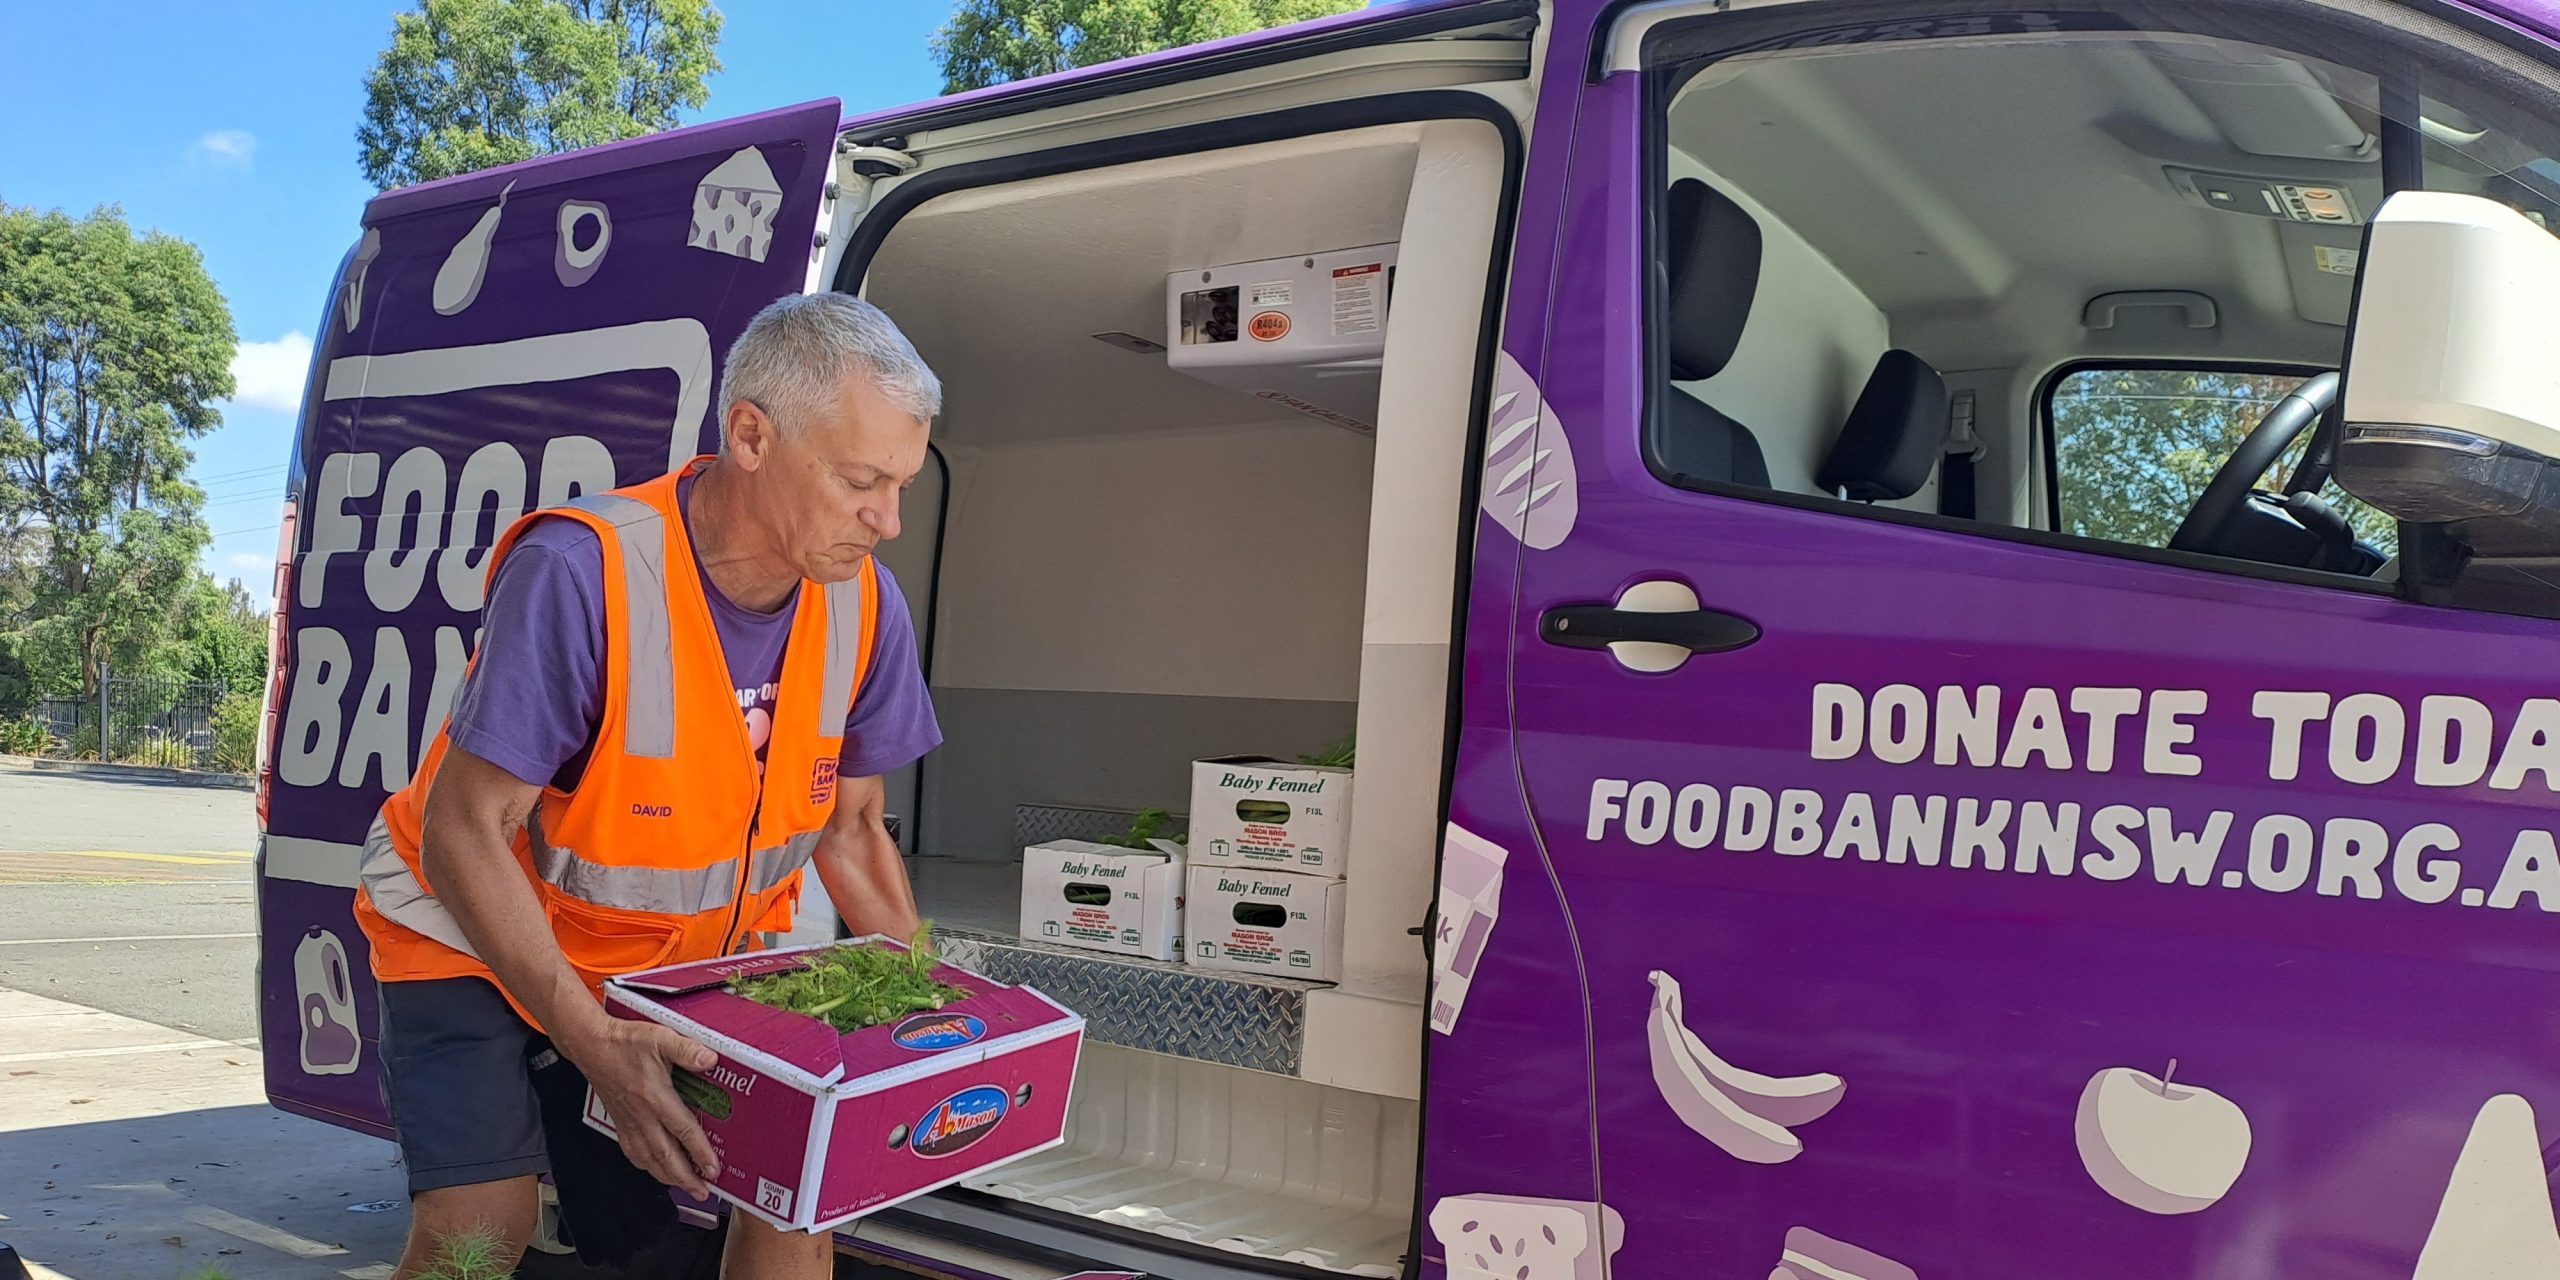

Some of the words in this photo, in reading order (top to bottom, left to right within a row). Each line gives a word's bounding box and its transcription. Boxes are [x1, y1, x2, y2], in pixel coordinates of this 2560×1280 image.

[279, 626, 484, 793] BAN
[1810, 683, 2208, 777] DONATE
[2251, 690, 2560, 792] TODA
[1219, 773, 1263, 793] Baby
[1266, 776, 1326, 794] Fennel
[632, 804, 672, 817] DAVID
[1305, 807, 1323, 816] F13L
[1244, 827, 1268, 835] MASON
[1217, 844, 1221, 853] 1
[1586, 778, 2560, 913] FOODBANKNSW.ORG.A
[1061, 861, 1089, 878] Baby
[1091, 864, 1127, 878] Fennel
[1216, 878, 1248, 896] Baby
[1251, 881, 1292, 897] Fennel
[1290, 912, 1307, 920] F13L
[1231, 932, 1255, 940] MASON
[1204, 946, 1208, 955] 1
[704, 1064, 758, 1096] ennel
[952, 1106, 998, 1136] Mason
[764, 1182, 785, 1196] COUNT
[763, 1191, 782, 1211] 20
[821, 1205, 849, 1219] Produce
[849, 1202, 857, 1212] of
[858, 1192, 887, 1208] Australia
